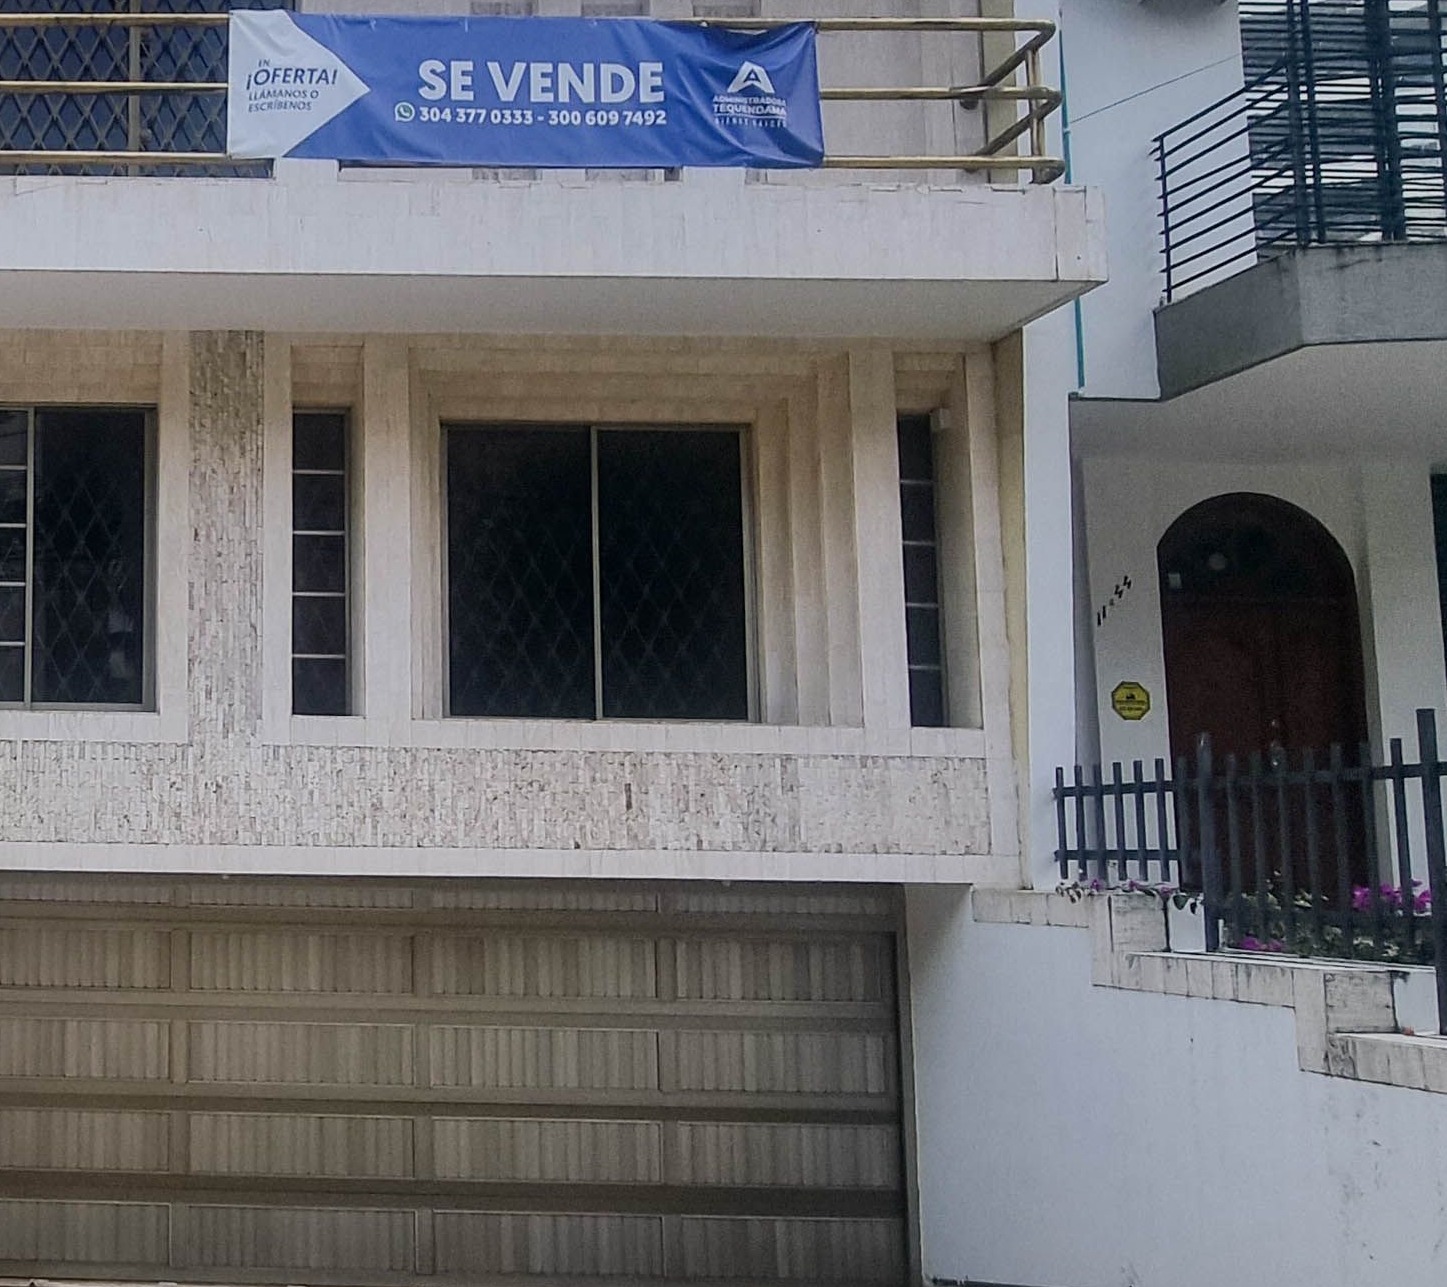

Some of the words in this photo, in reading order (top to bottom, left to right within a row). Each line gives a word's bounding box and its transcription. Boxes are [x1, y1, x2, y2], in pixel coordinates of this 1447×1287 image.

[246, 67, 338, 90] ¡OFERTA!
[418, 60, 474, 101] SE
[487, 61, 664, 103] VENDE
[310, 89, 319, 99] O
[419, 106, 451, 123] 304
[456, 108, 487, 124] 377
[491, 109, 533, 125] 0333
[548, 110, 581, 126] 300
[585, 110, 619, 126] 609
[623, 110, 667, 126] 7492
[713, 103, 787, 116] TEQUENDAMA
